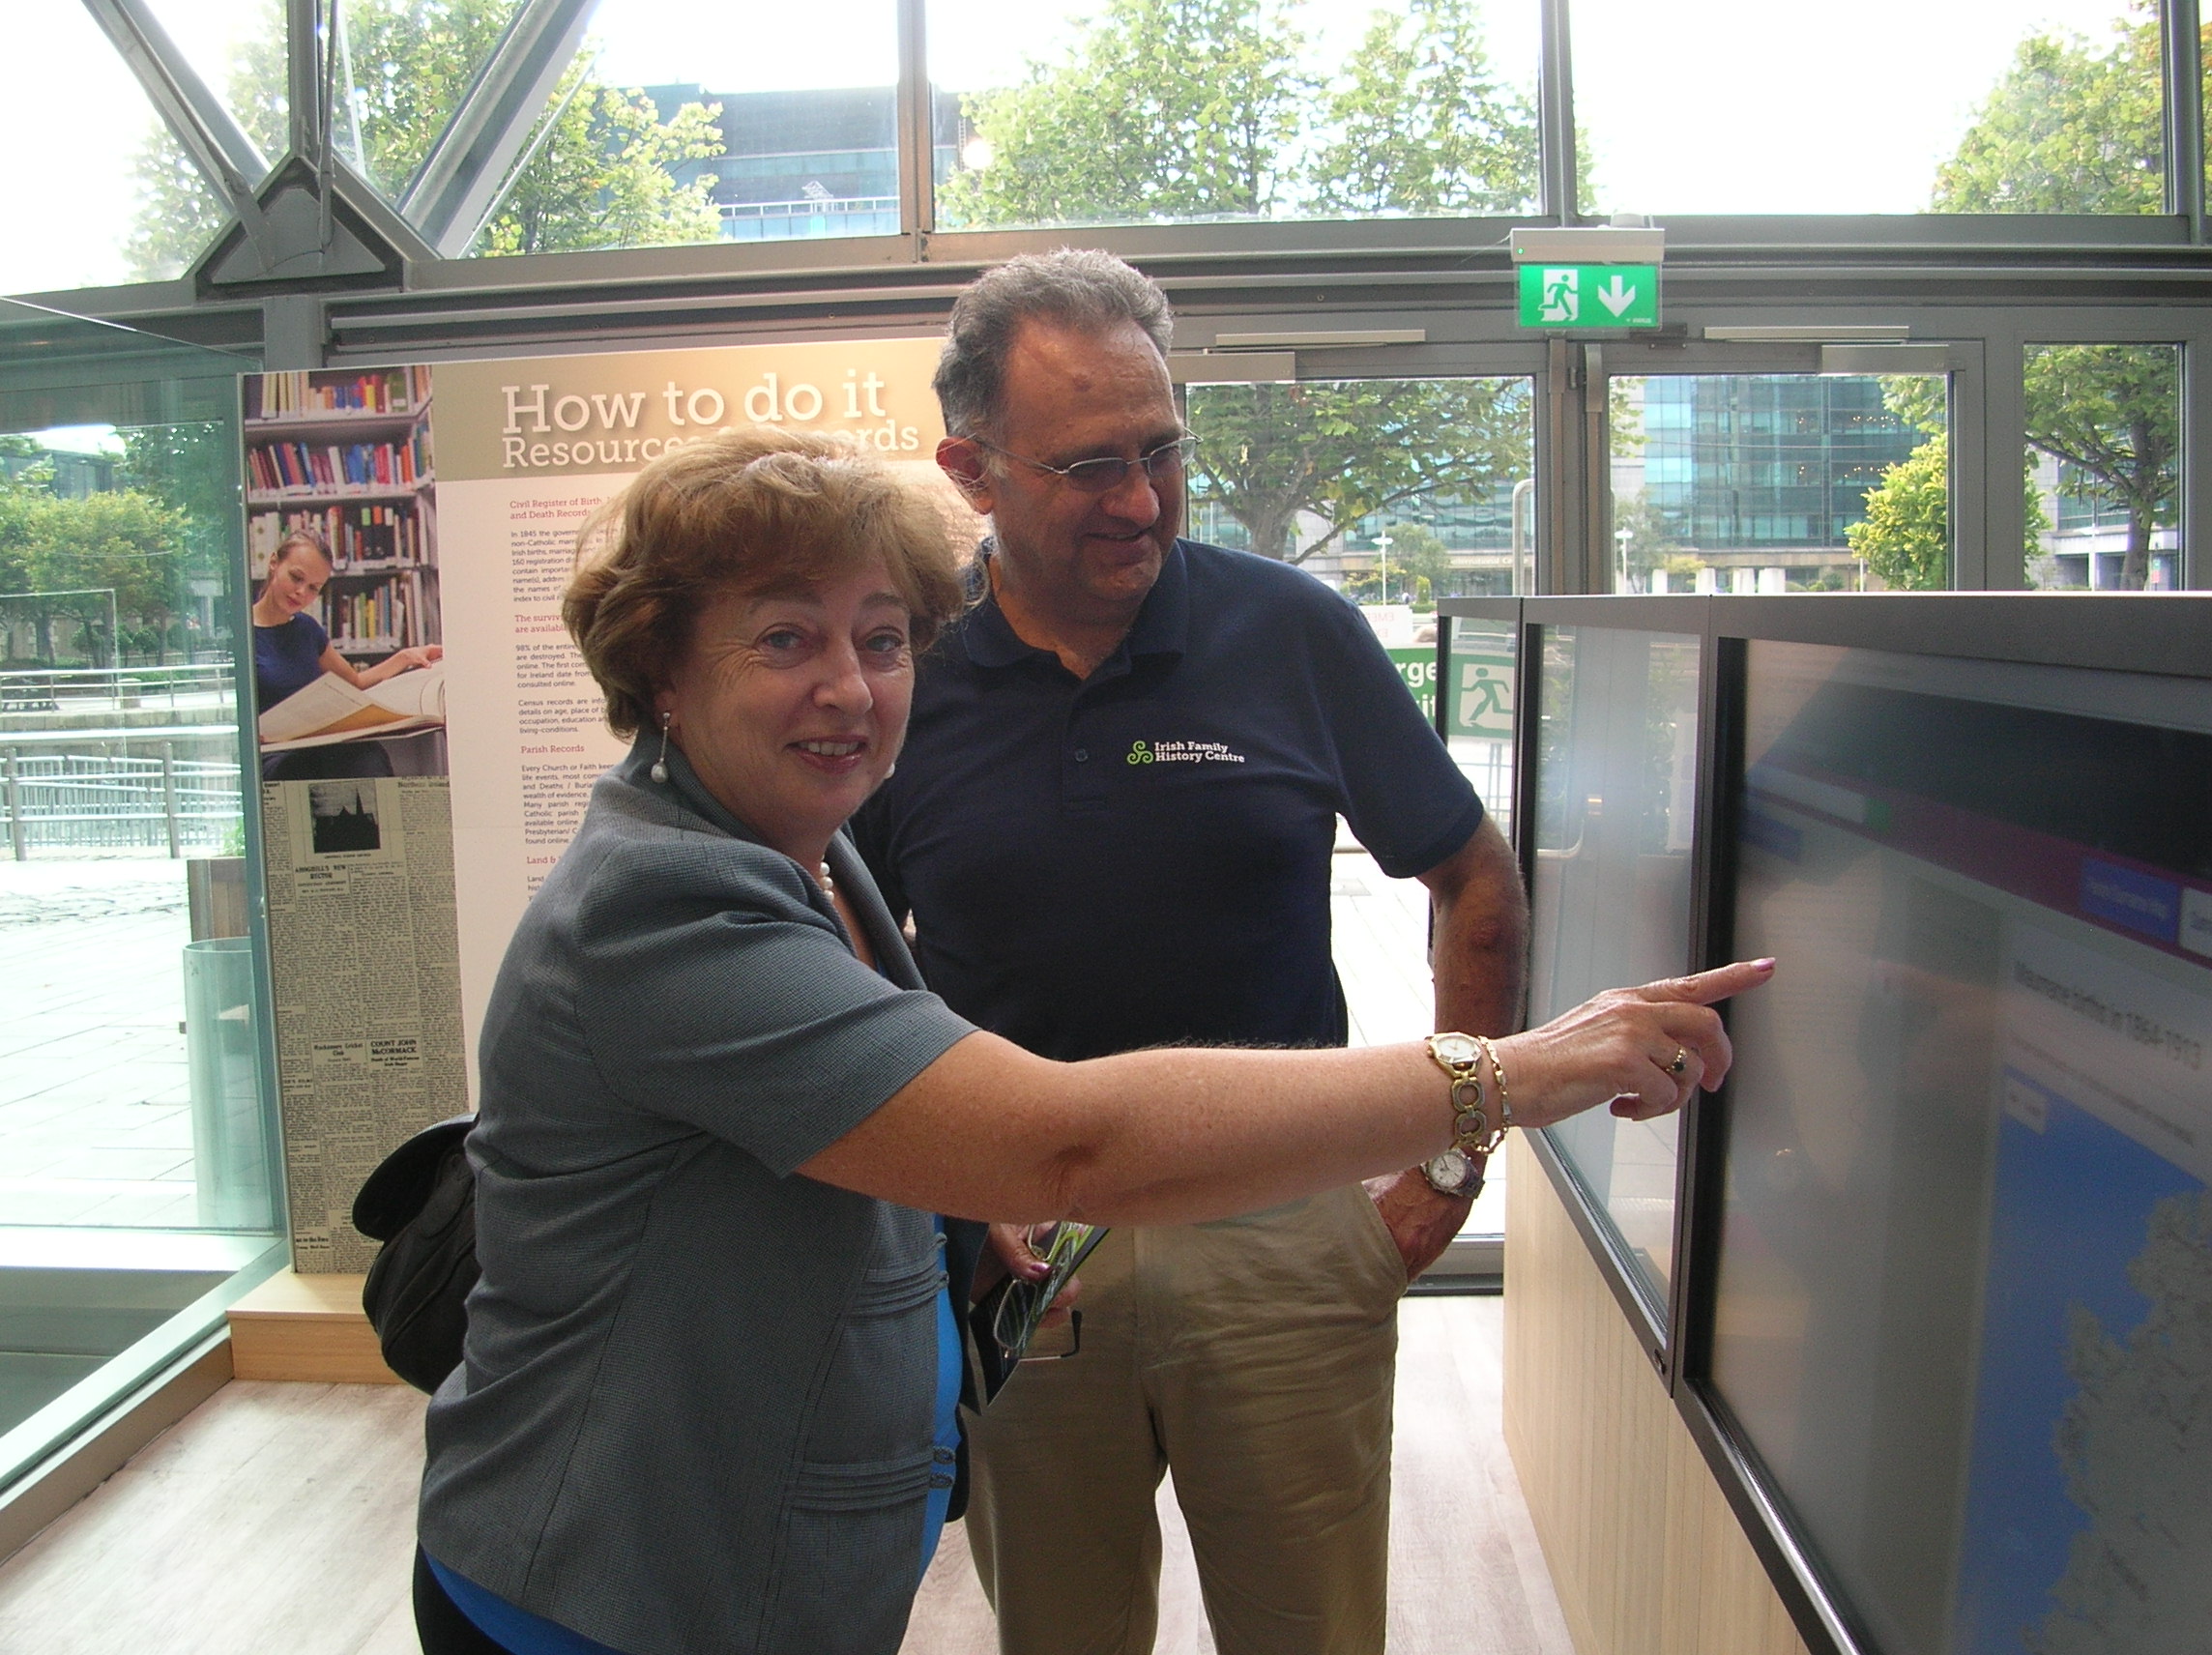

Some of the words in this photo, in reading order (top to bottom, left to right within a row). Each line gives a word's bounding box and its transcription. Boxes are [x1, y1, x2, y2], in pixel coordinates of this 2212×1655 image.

[502, 384, 647, 435] How
[662, 381, 724, 426] to
[743, 372, 824, 423] do
[842, 368, 888, 420] it
[533, 500, 567, 508] Register
[510, 510, 527, 519] and
[519, 726, 578, 735] living-conditions.
[521, 745, 547, 754] Parish
[550, 744, 585, 753] Records
[1154, 741, 1185, 751] Irish
[1186, 740, 1229, 753] Family
[1155, 752, 1203, 763] History
[1205, 751, 1245, 763] Centre
[370, 1039, 395, 1048] COUNT
